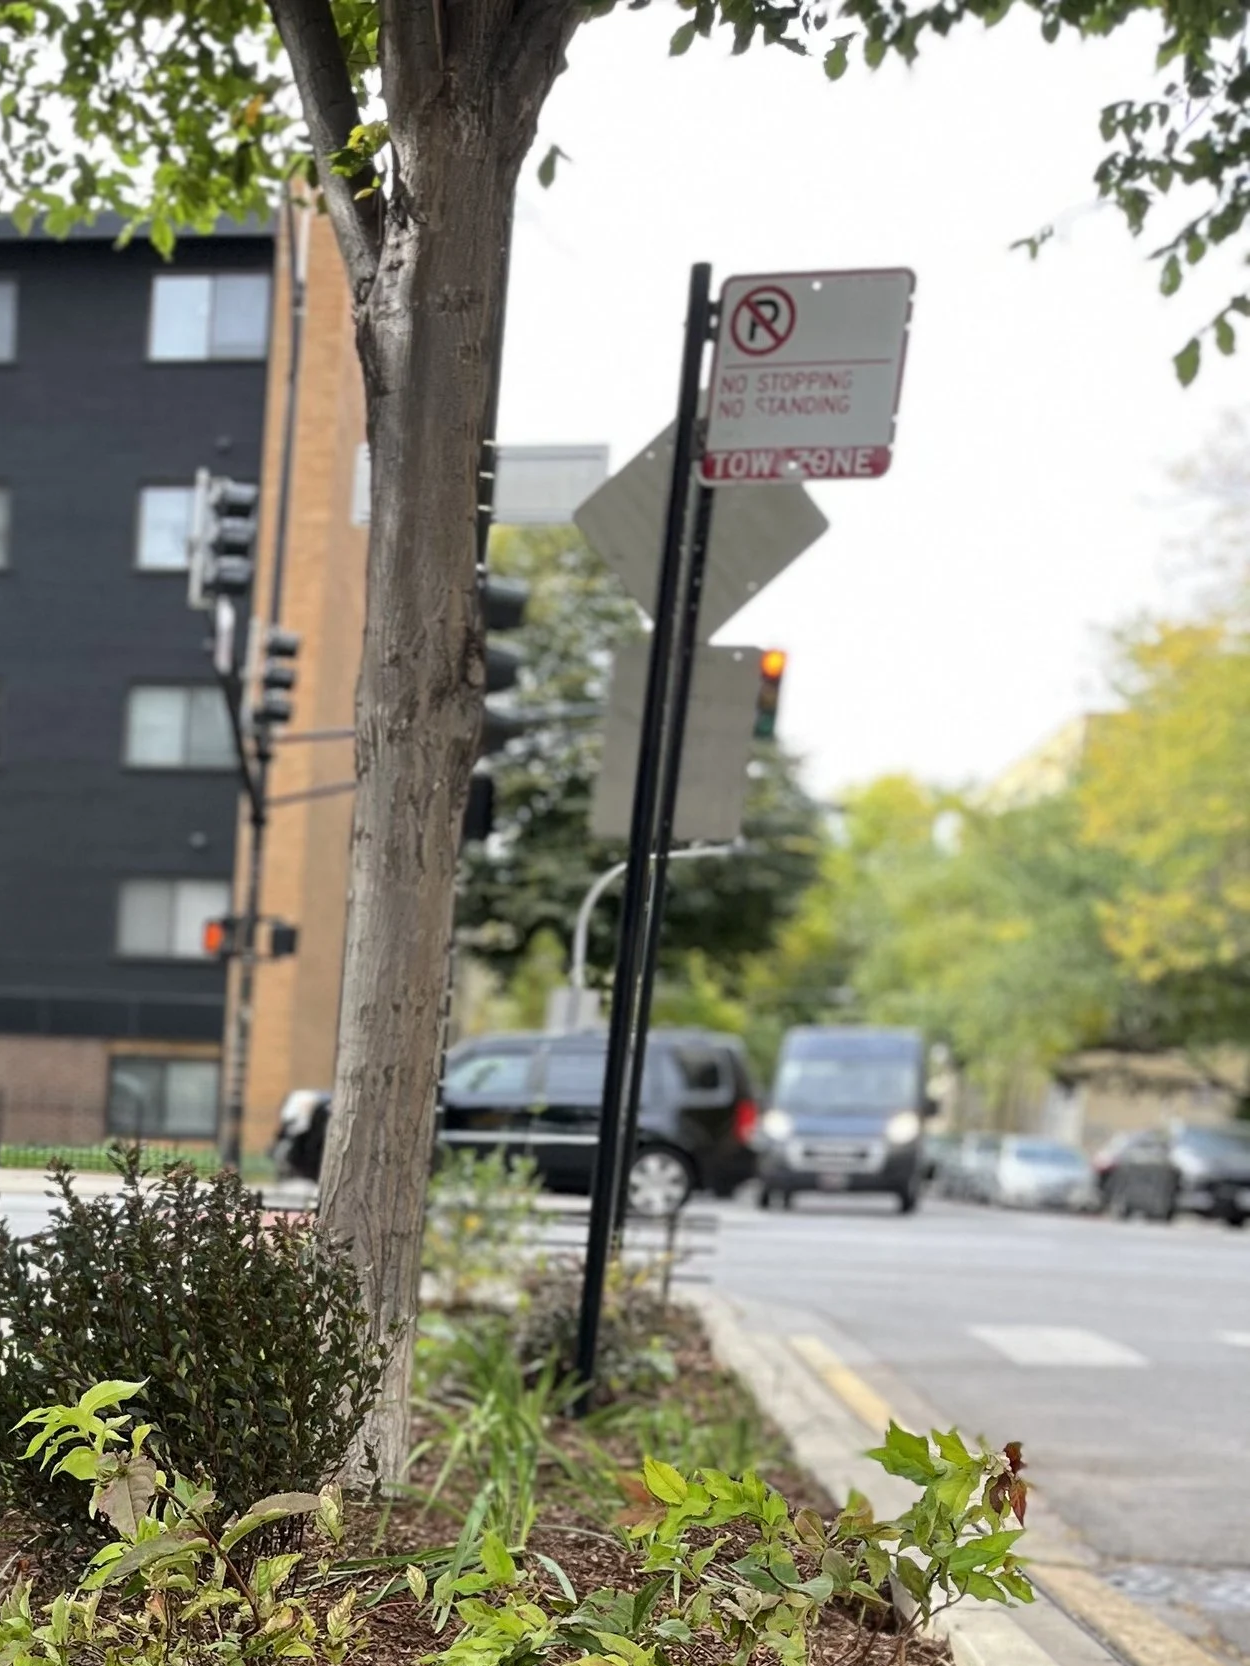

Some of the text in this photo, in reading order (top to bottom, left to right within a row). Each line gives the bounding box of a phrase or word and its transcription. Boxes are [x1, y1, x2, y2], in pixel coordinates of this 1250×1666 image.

[720, 371, 853, 394] NO STOPPING
[718, 395, 851, 419] NO STANDING
[711, 448, 873, 477] TOW ZONE
